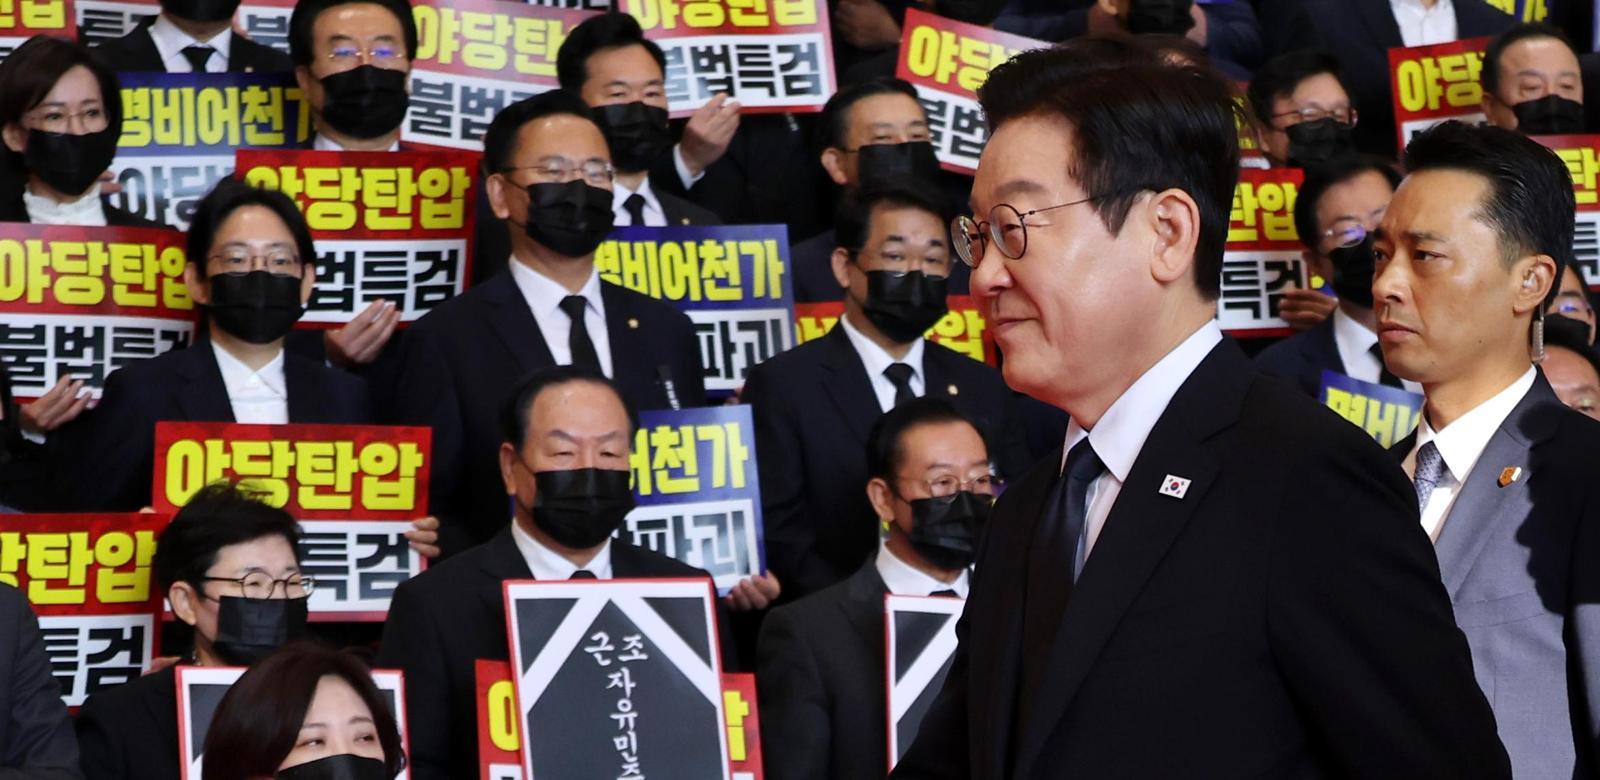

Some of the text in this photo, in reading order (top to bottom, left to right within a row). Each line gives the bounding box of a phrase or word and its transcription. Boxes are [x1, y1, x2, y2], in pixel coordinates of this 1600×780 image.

[412, 5, 579, 76] 야당탄
[408, 78, 536, 140] 불법
[1397, 51, 1485, 112] 야당
[118, 165, 234, 223] 야당
[0, 239, 194, 310] 야당탄압
[0, 322, 192, 390] 불법특
[165, 438, 424, 510] 야당탄압
